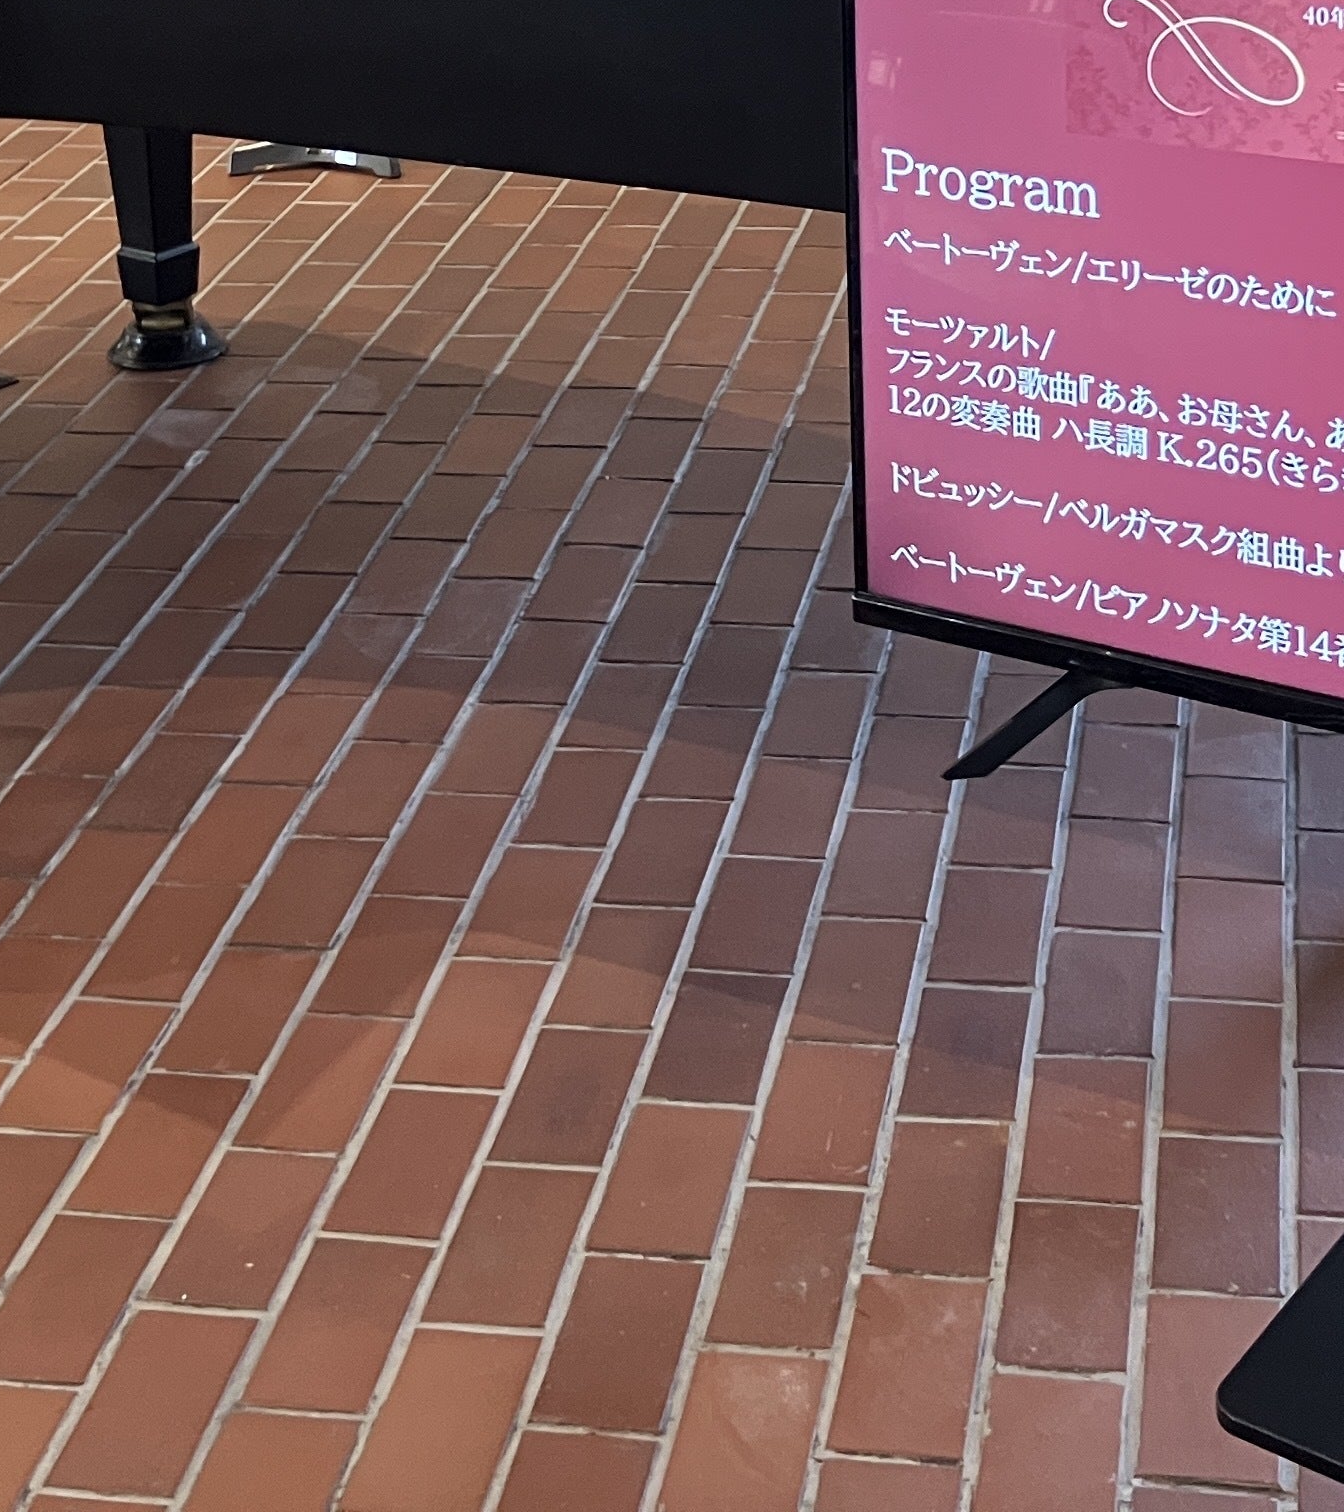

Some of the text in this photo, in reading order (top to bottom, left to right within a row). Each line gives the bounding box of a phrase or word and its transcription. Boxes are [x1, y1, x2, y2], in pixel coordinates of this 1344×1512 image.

[881, 148, 1101, 220] Program
[884, 229, 1337, 318] ベートーヴェン/エリーゼのために
[884, 307, 1056, 360] モーツァルト/
[888, 385, 1042, 442] 12の変奏曲
[1053, 418, 1149, 462] ハ長調
